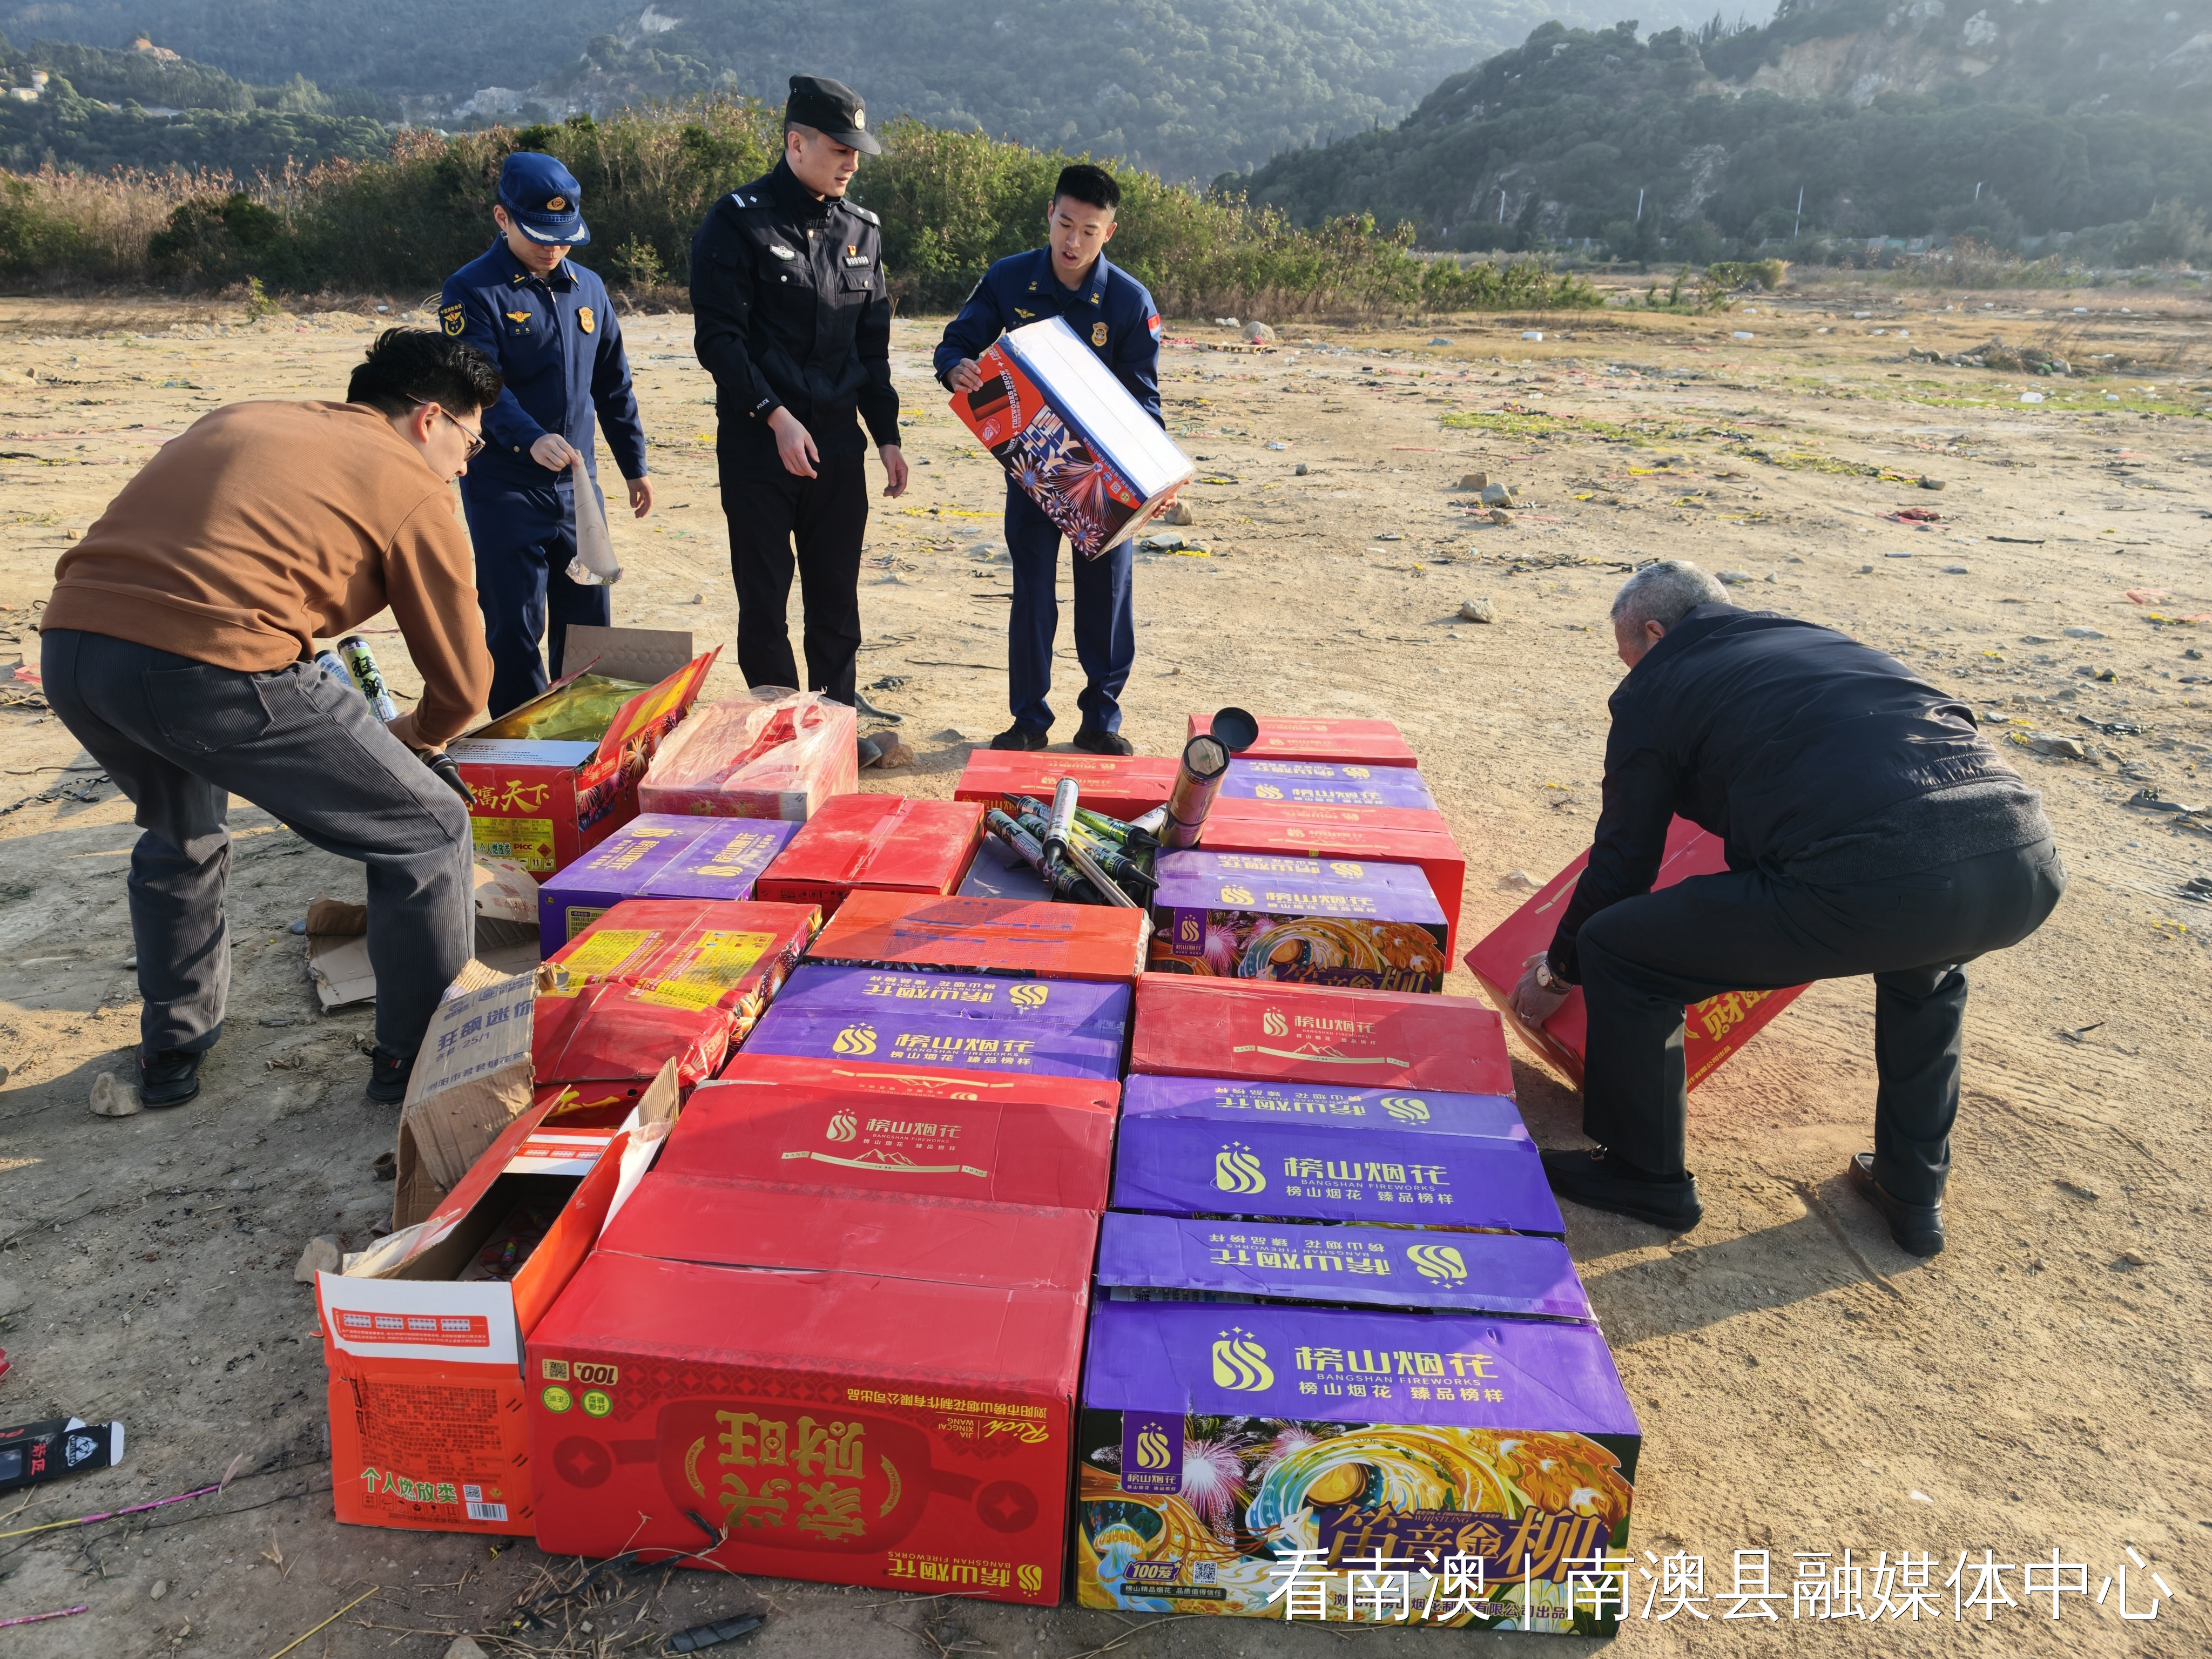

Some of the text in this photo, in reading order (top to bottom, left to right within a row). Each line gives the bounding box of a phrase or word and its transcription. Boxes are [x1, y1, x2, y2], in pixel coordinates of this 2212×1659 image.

[1000, 369, 1012, 390] SHOW
[1008, 390, 1017, 428] FIREWORKS
[1266, 893, 1375, 906] 榜山烟花
[861, 983, 993, 1004] 榜山烟花
[938, 980, 996, 990] 榜山烟花
[1294, 1015, 1377, 1034] 榜山烟花
[896, 1034, 1036, 1054] 榜山烟花
[890, 1050, 954, 1062] 榜山烟花
[1229, 1092, 1289, 1101] FIREWORKS
[1292, 1091, 1363, 1102] 榜山烟花
[1216, 1096, 1367, 1117] 榜山烟花
[866, 1118, 963, 1139] 榜山烟花
[863, 1138, 903, 1148] 榜山烟花
[965, 1166, 986, 1177] SHAN
[1283, 1157, 1450, 1186] 榜山烟花
[1286, 1185, 1455, 1204] 榜山烟花 臻品榜样
[1301, 1179, 1436, 1192] BANGSHAN FIREWORKS
[1209, 1233, 1386, 1253] 榜山烟花 臻品榜样
[1225, 1243, 1370, 1258] BANGSHAN FIREWORKS
[1210, 1247, 1391, 1276] 榜山烟花
[1295, 1346, 1499, 1380] 榜山烟花
[1316, 1373, 1482, 1386] BANGSHAN FIREWORKS
[1298, 1381, 1505, 1403] 榜山烟花 臻品榜样
[847, 1388, 1047, 1419] 浏阳市榜山烟花制作有限公司出品
[939, 1423, 974, 1433] XINGCAI
[947, 1418, 974, 1426] WANG
[983, 1420, 1049, 1444] Rich
[361, 1467, 458, 1504] 个人燃放类
[686, 1446, 900, 1509] FIREWORKS BANGSHAN
[1127, 1473, 1177, 1485] 榜山烟花
[1415, 1515, 1470, 1523] WHISTLING
[888, 1550, 1010, 1568] BANGSHAN FIREWORKS
[888, 1557, 1010, 1588] 榜山烟花
